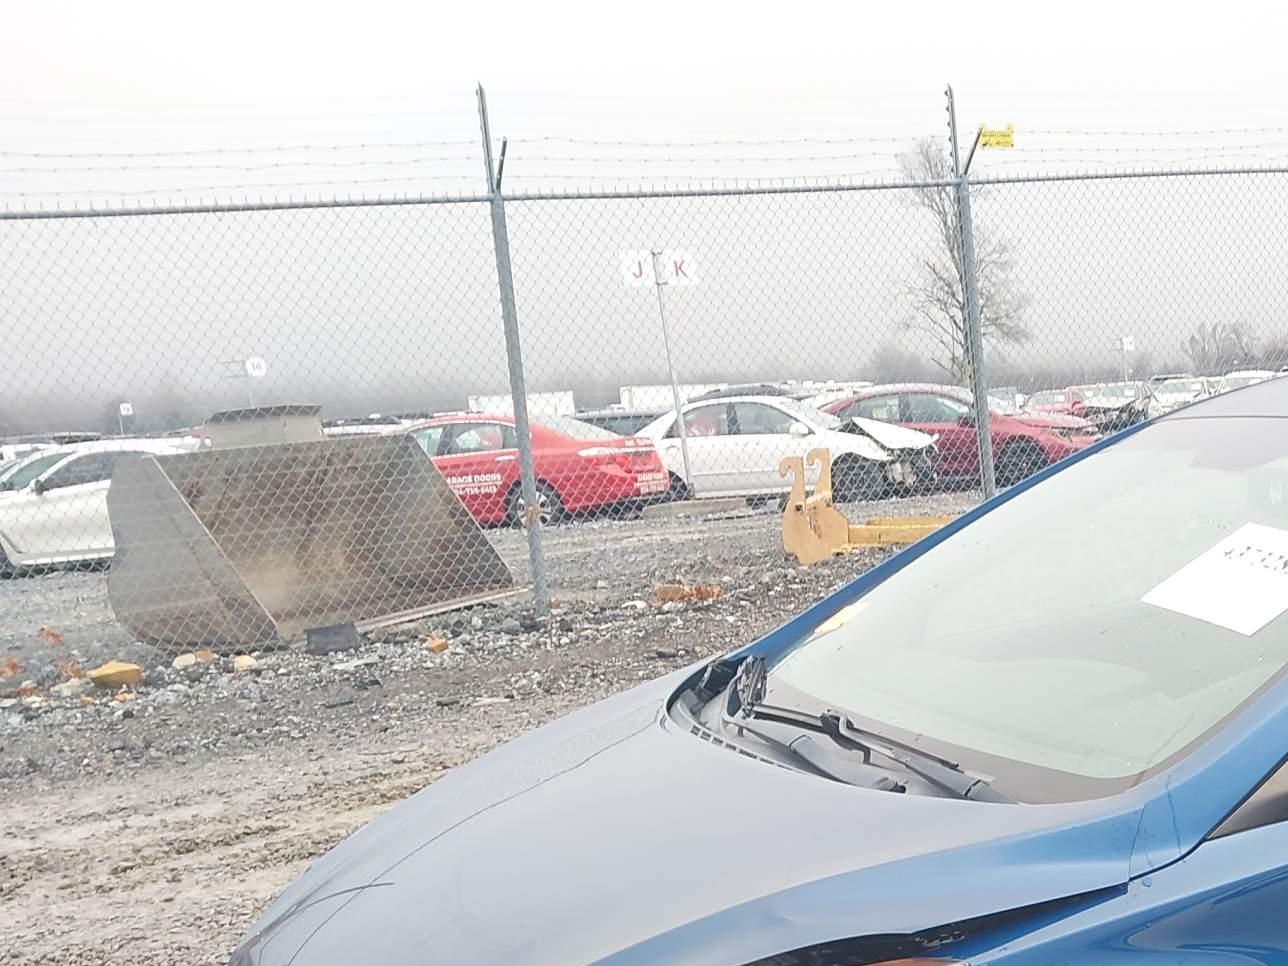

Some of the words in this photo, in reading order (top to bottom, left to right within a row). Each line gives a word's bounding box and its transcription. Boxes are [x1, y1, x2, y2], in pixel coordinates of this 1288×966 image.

[632, 261, 643, 279] J
[673, 260, 688, 278] K
[446, 474, 473, 485] ARAGE
[473, 472, 502, 483] DOORS
